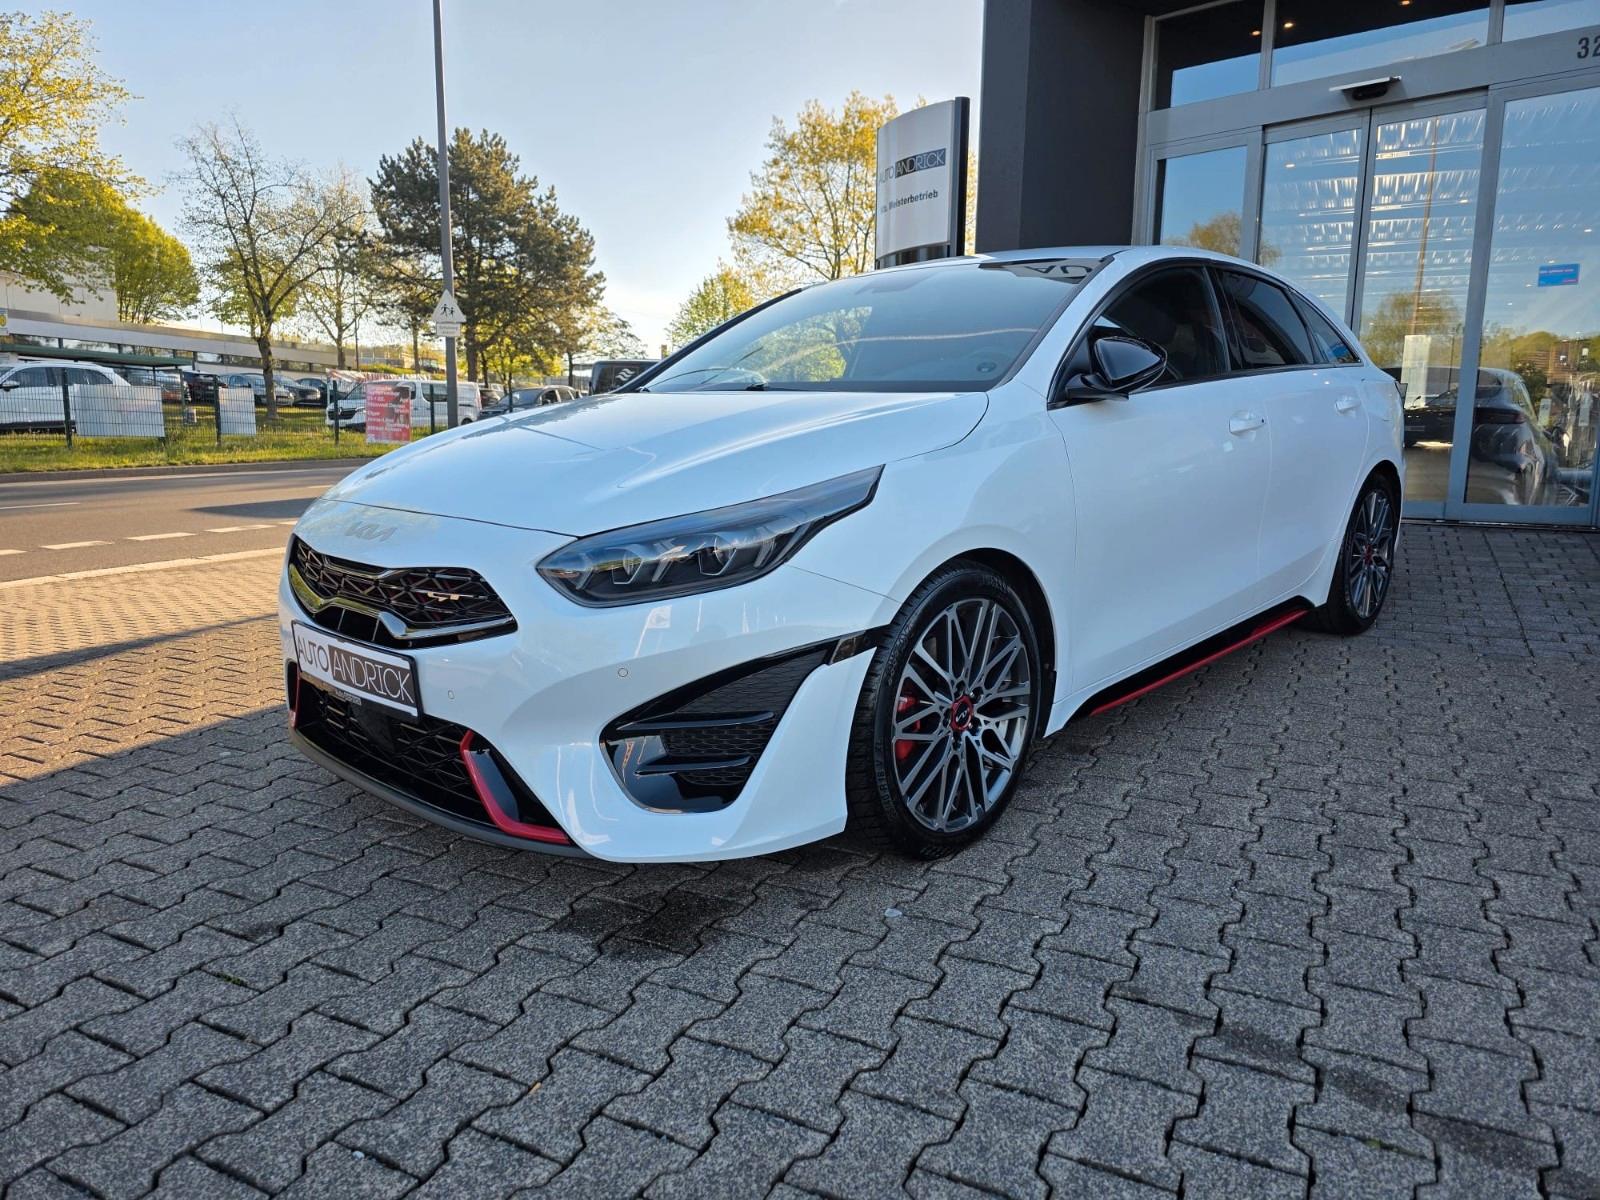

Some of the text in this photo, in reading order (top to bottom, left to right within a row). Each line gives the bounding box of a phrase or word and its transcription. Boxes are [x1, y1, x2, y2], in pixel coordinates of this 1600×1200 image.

[896, 150, 945, 176] ANDRICK
[297, 635, 414, 704] AUTO ANDRICK
